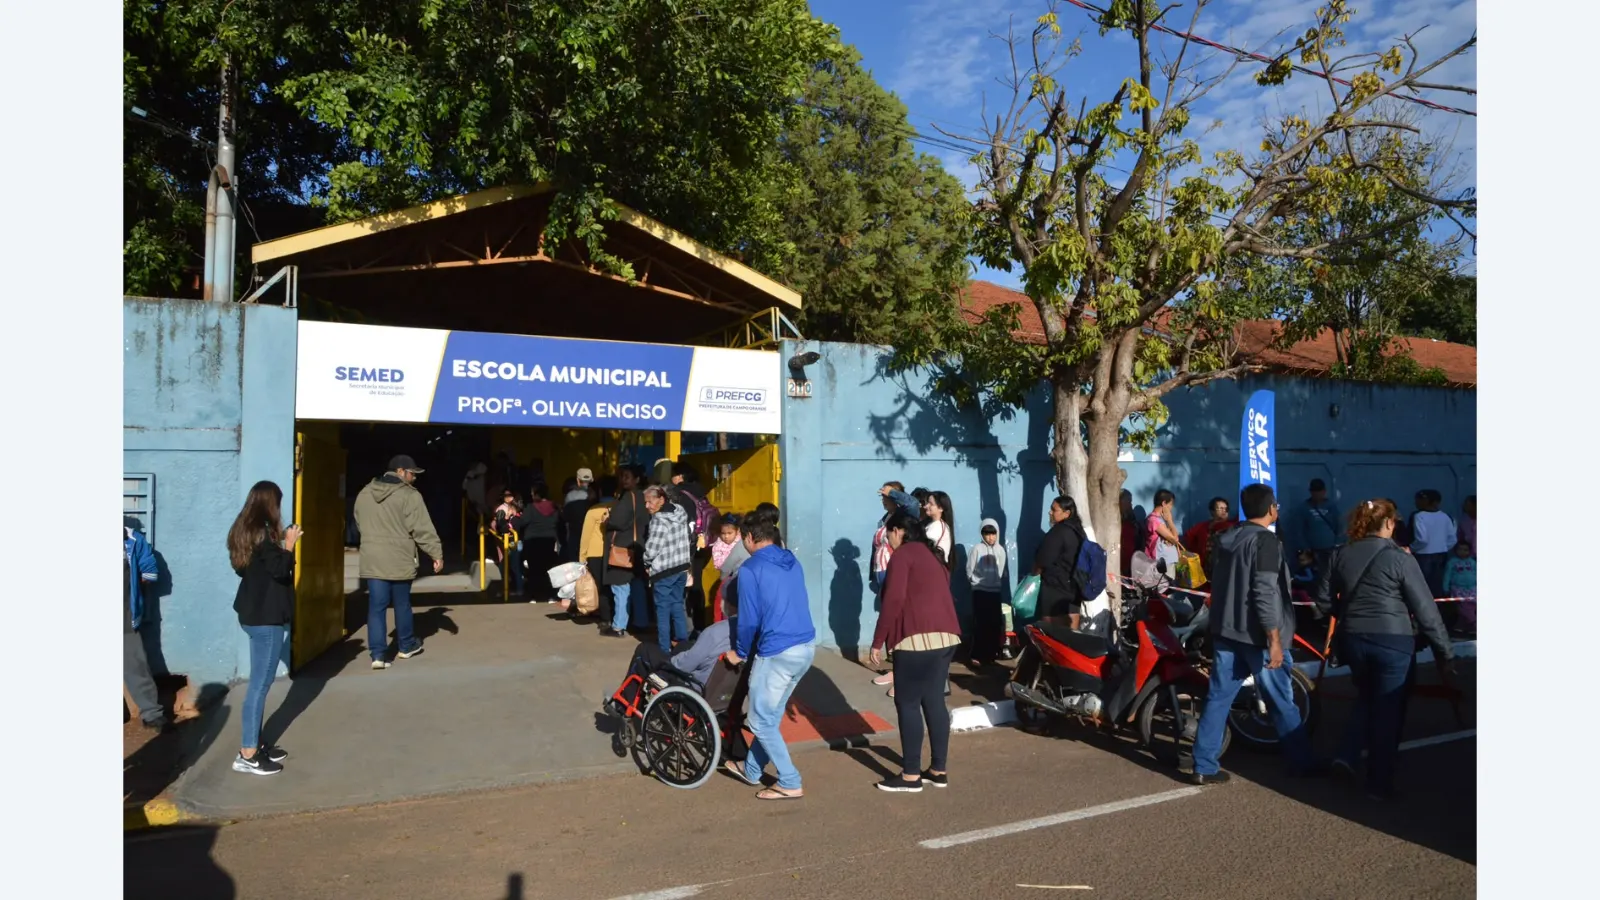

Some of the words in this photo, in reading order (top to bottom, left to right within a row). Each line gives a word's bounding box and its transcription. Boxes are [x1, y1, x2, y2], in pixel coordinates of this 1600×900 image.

[334, 366, 405, 383] SEMED
[452, 359, 546, 382] ESCOLA
[550, 365, 672, 388] MUNICIPAL
[715, 390, 762, 402] PREFCG
[531, 399, 591, 418] OLIVA
[595, 402, 667, 420] ENCISO
